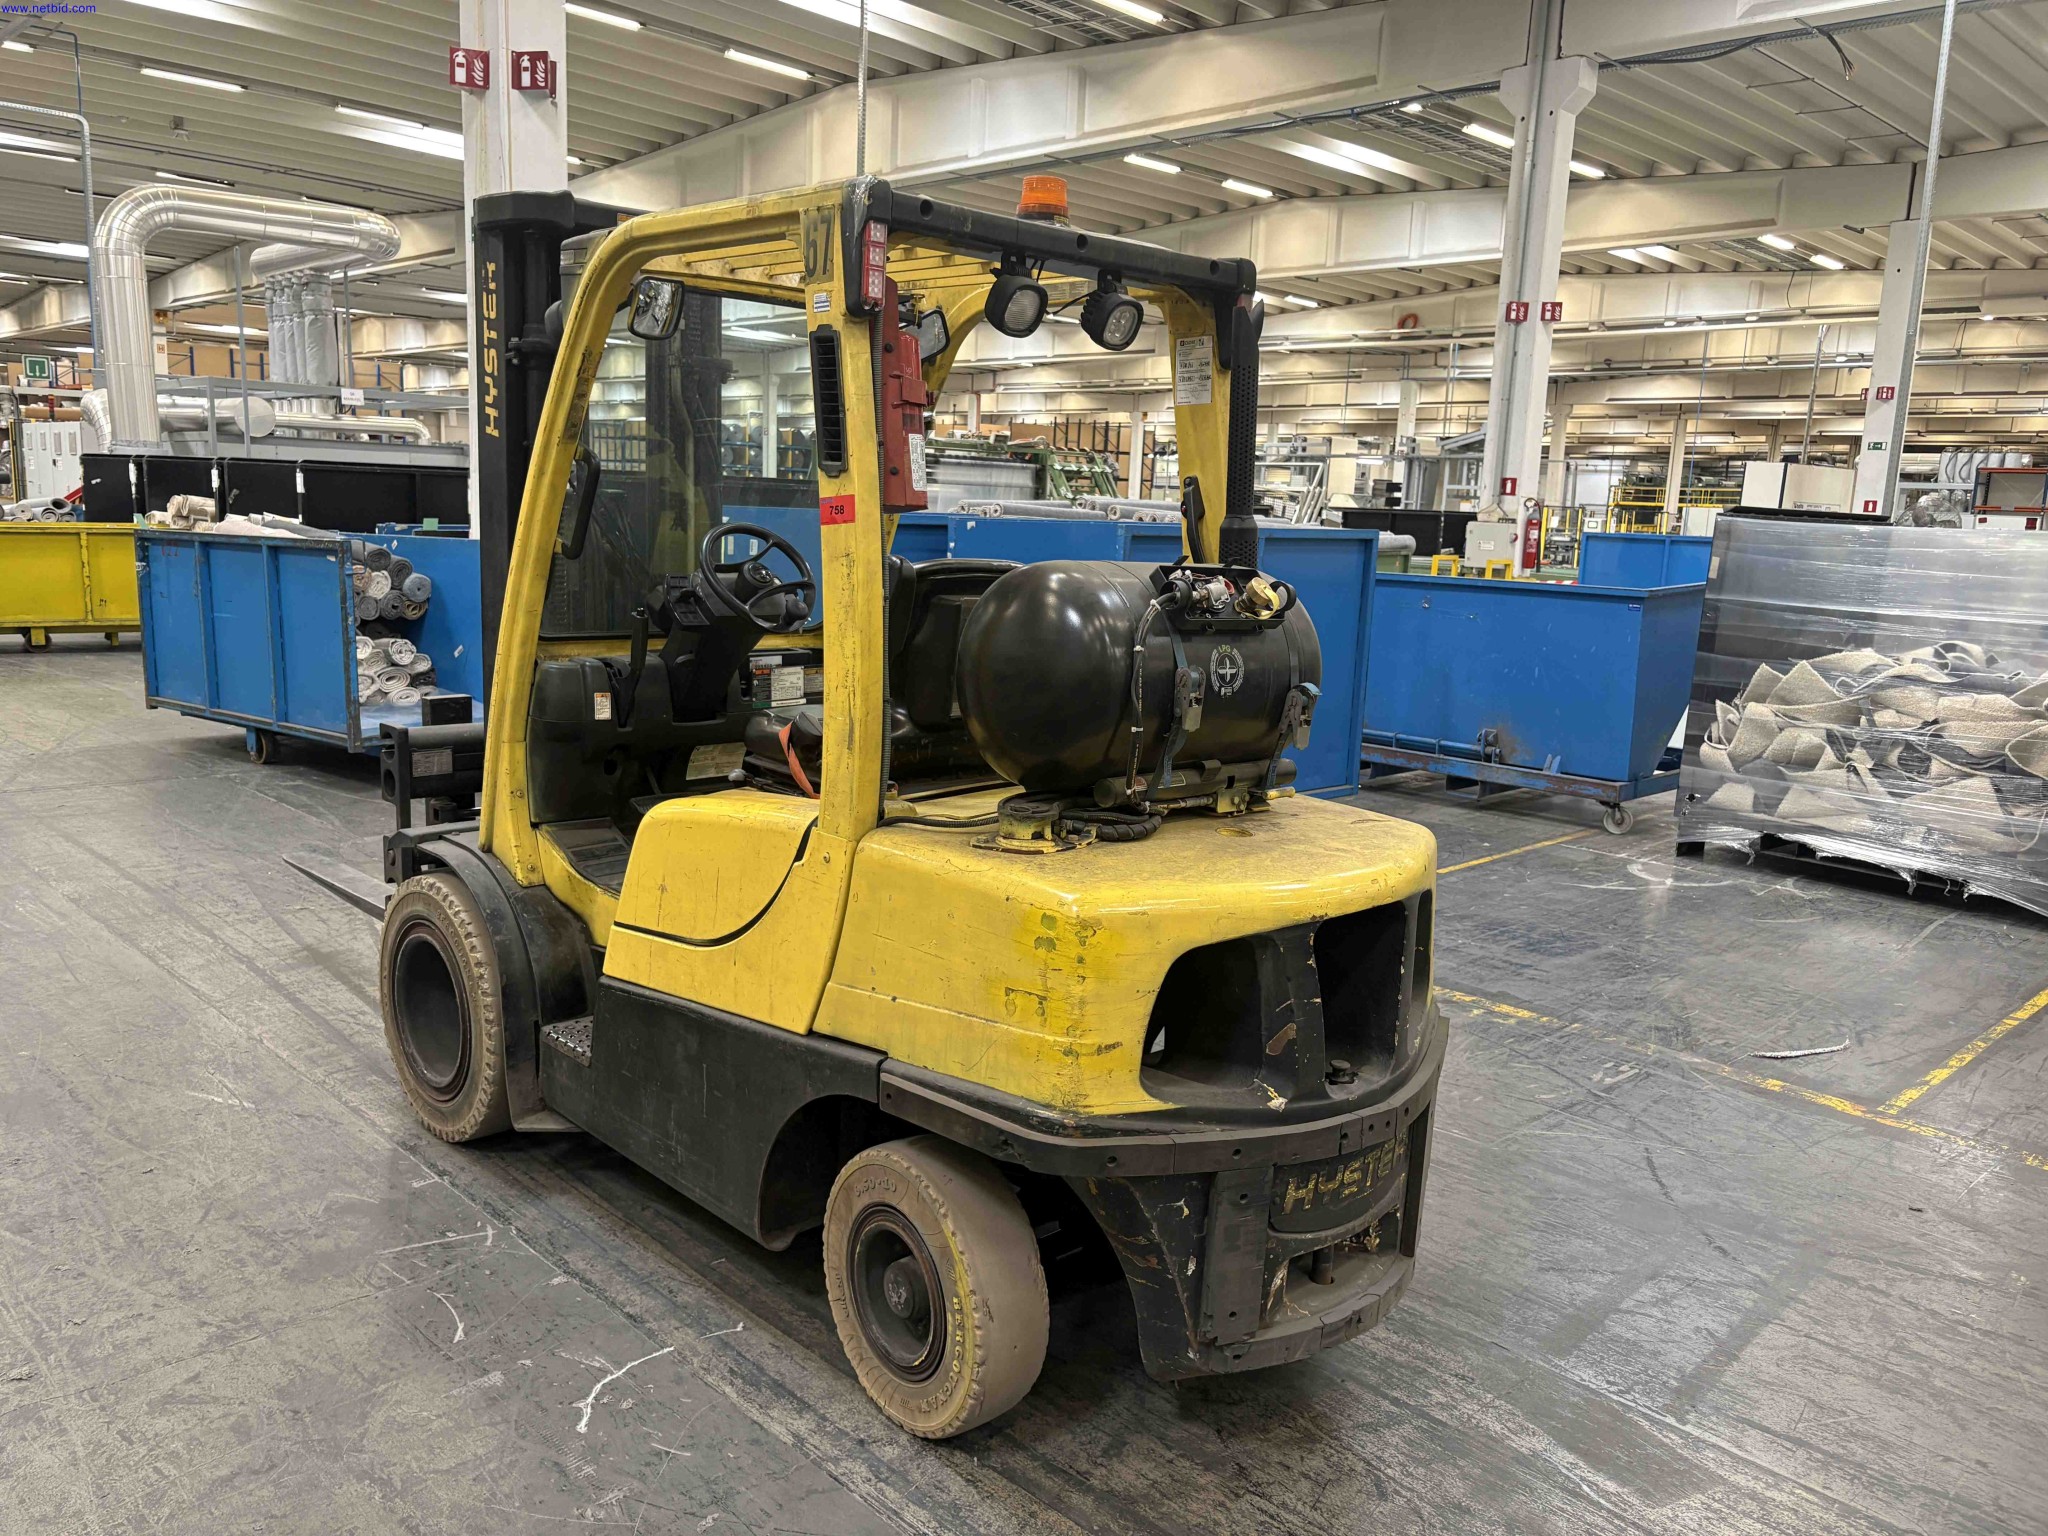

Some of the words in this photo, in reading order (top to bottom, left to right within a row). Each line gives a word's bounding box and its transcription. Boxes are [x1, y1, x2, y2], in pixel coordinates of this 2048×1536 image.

[805, 213, 833, 278] 67
[829, 504, 845, 516] 758
[1218, 644, 1231, 653] LPG
